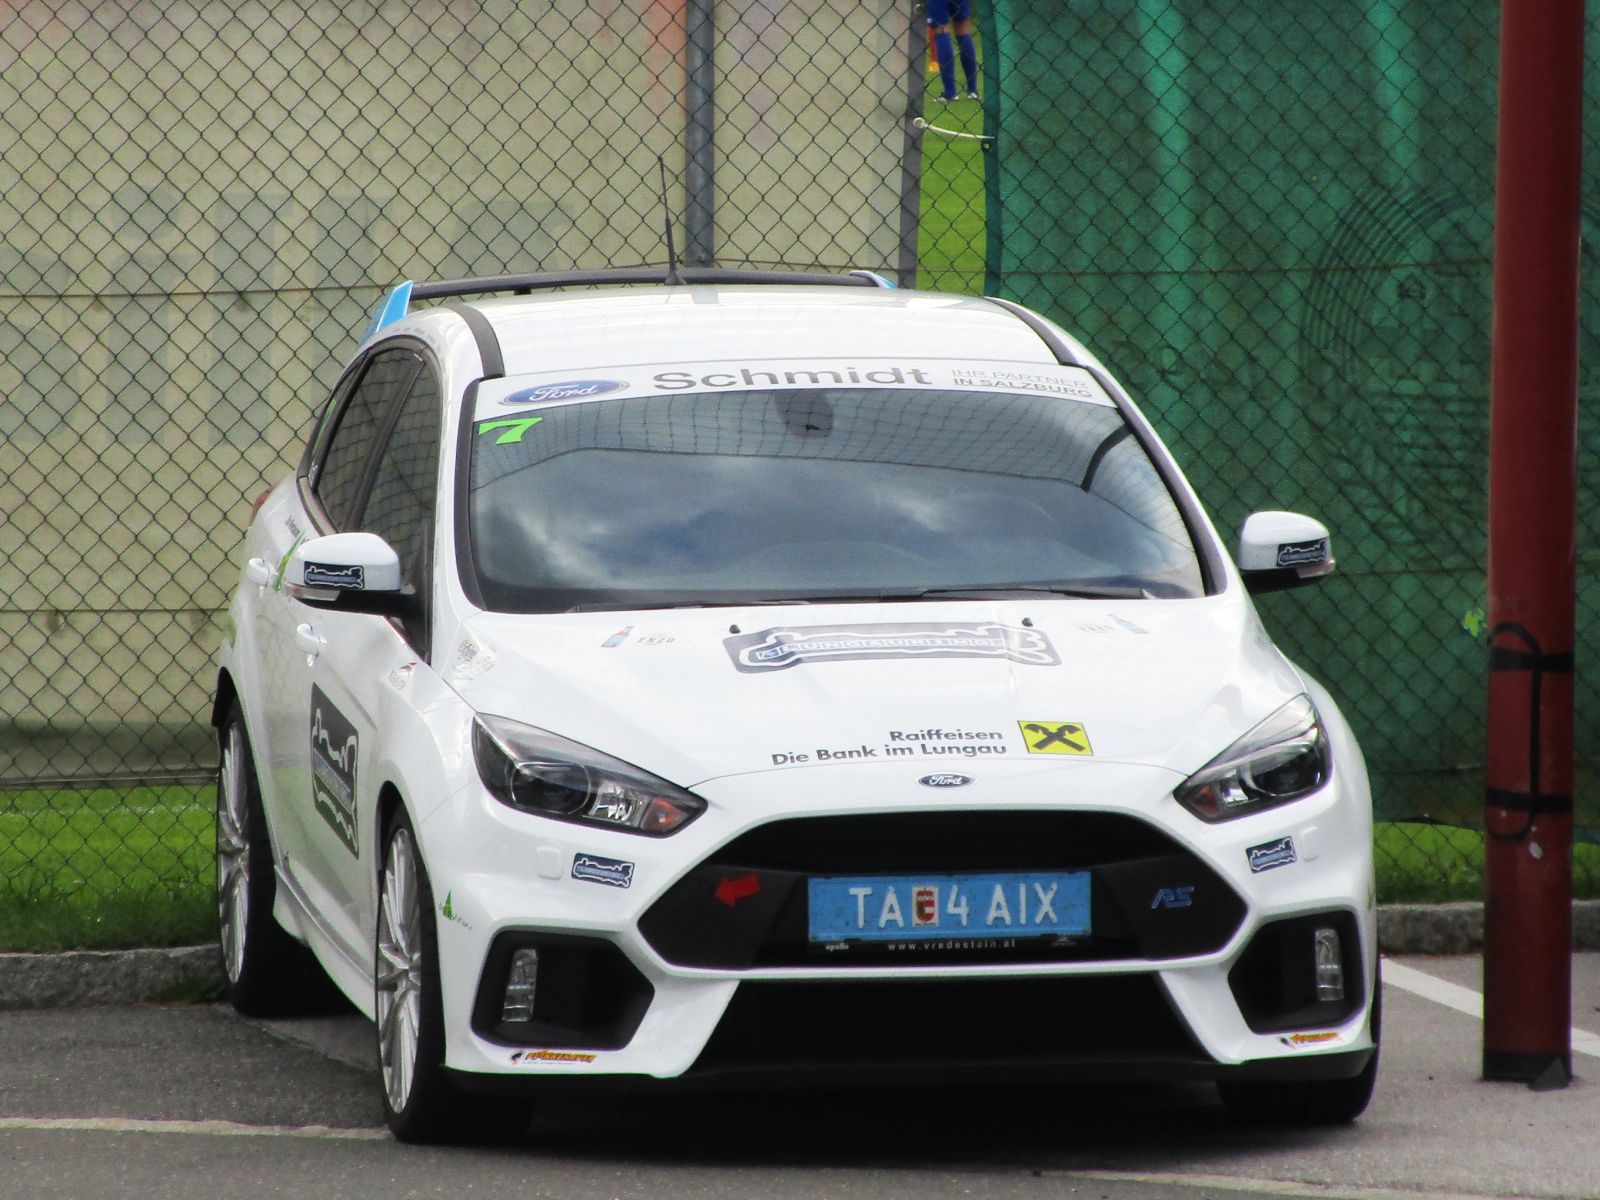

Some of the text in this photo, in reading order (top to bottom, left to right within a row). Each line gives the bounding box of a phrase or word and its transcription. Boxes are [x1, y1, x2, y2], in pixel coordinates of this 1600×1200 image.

[653, 366, 933, 391] Schmidt
[952, 368, 1089, 388] IHR PARTNER
[953, 377, 1093, 398] IN SALZBURG
[529, 383, 599, 402] Ford
[478, 416, 544, 445] 7
[889, 729, 1003, 742] Raiffeisen
[771, 743, 1007, 766] Die Bank im Lungau
[928, 774, 964, 786] Ford
[848, 882, 1059, 929] TA 4 AIX
[1151, 886, 1195, 909] RS
